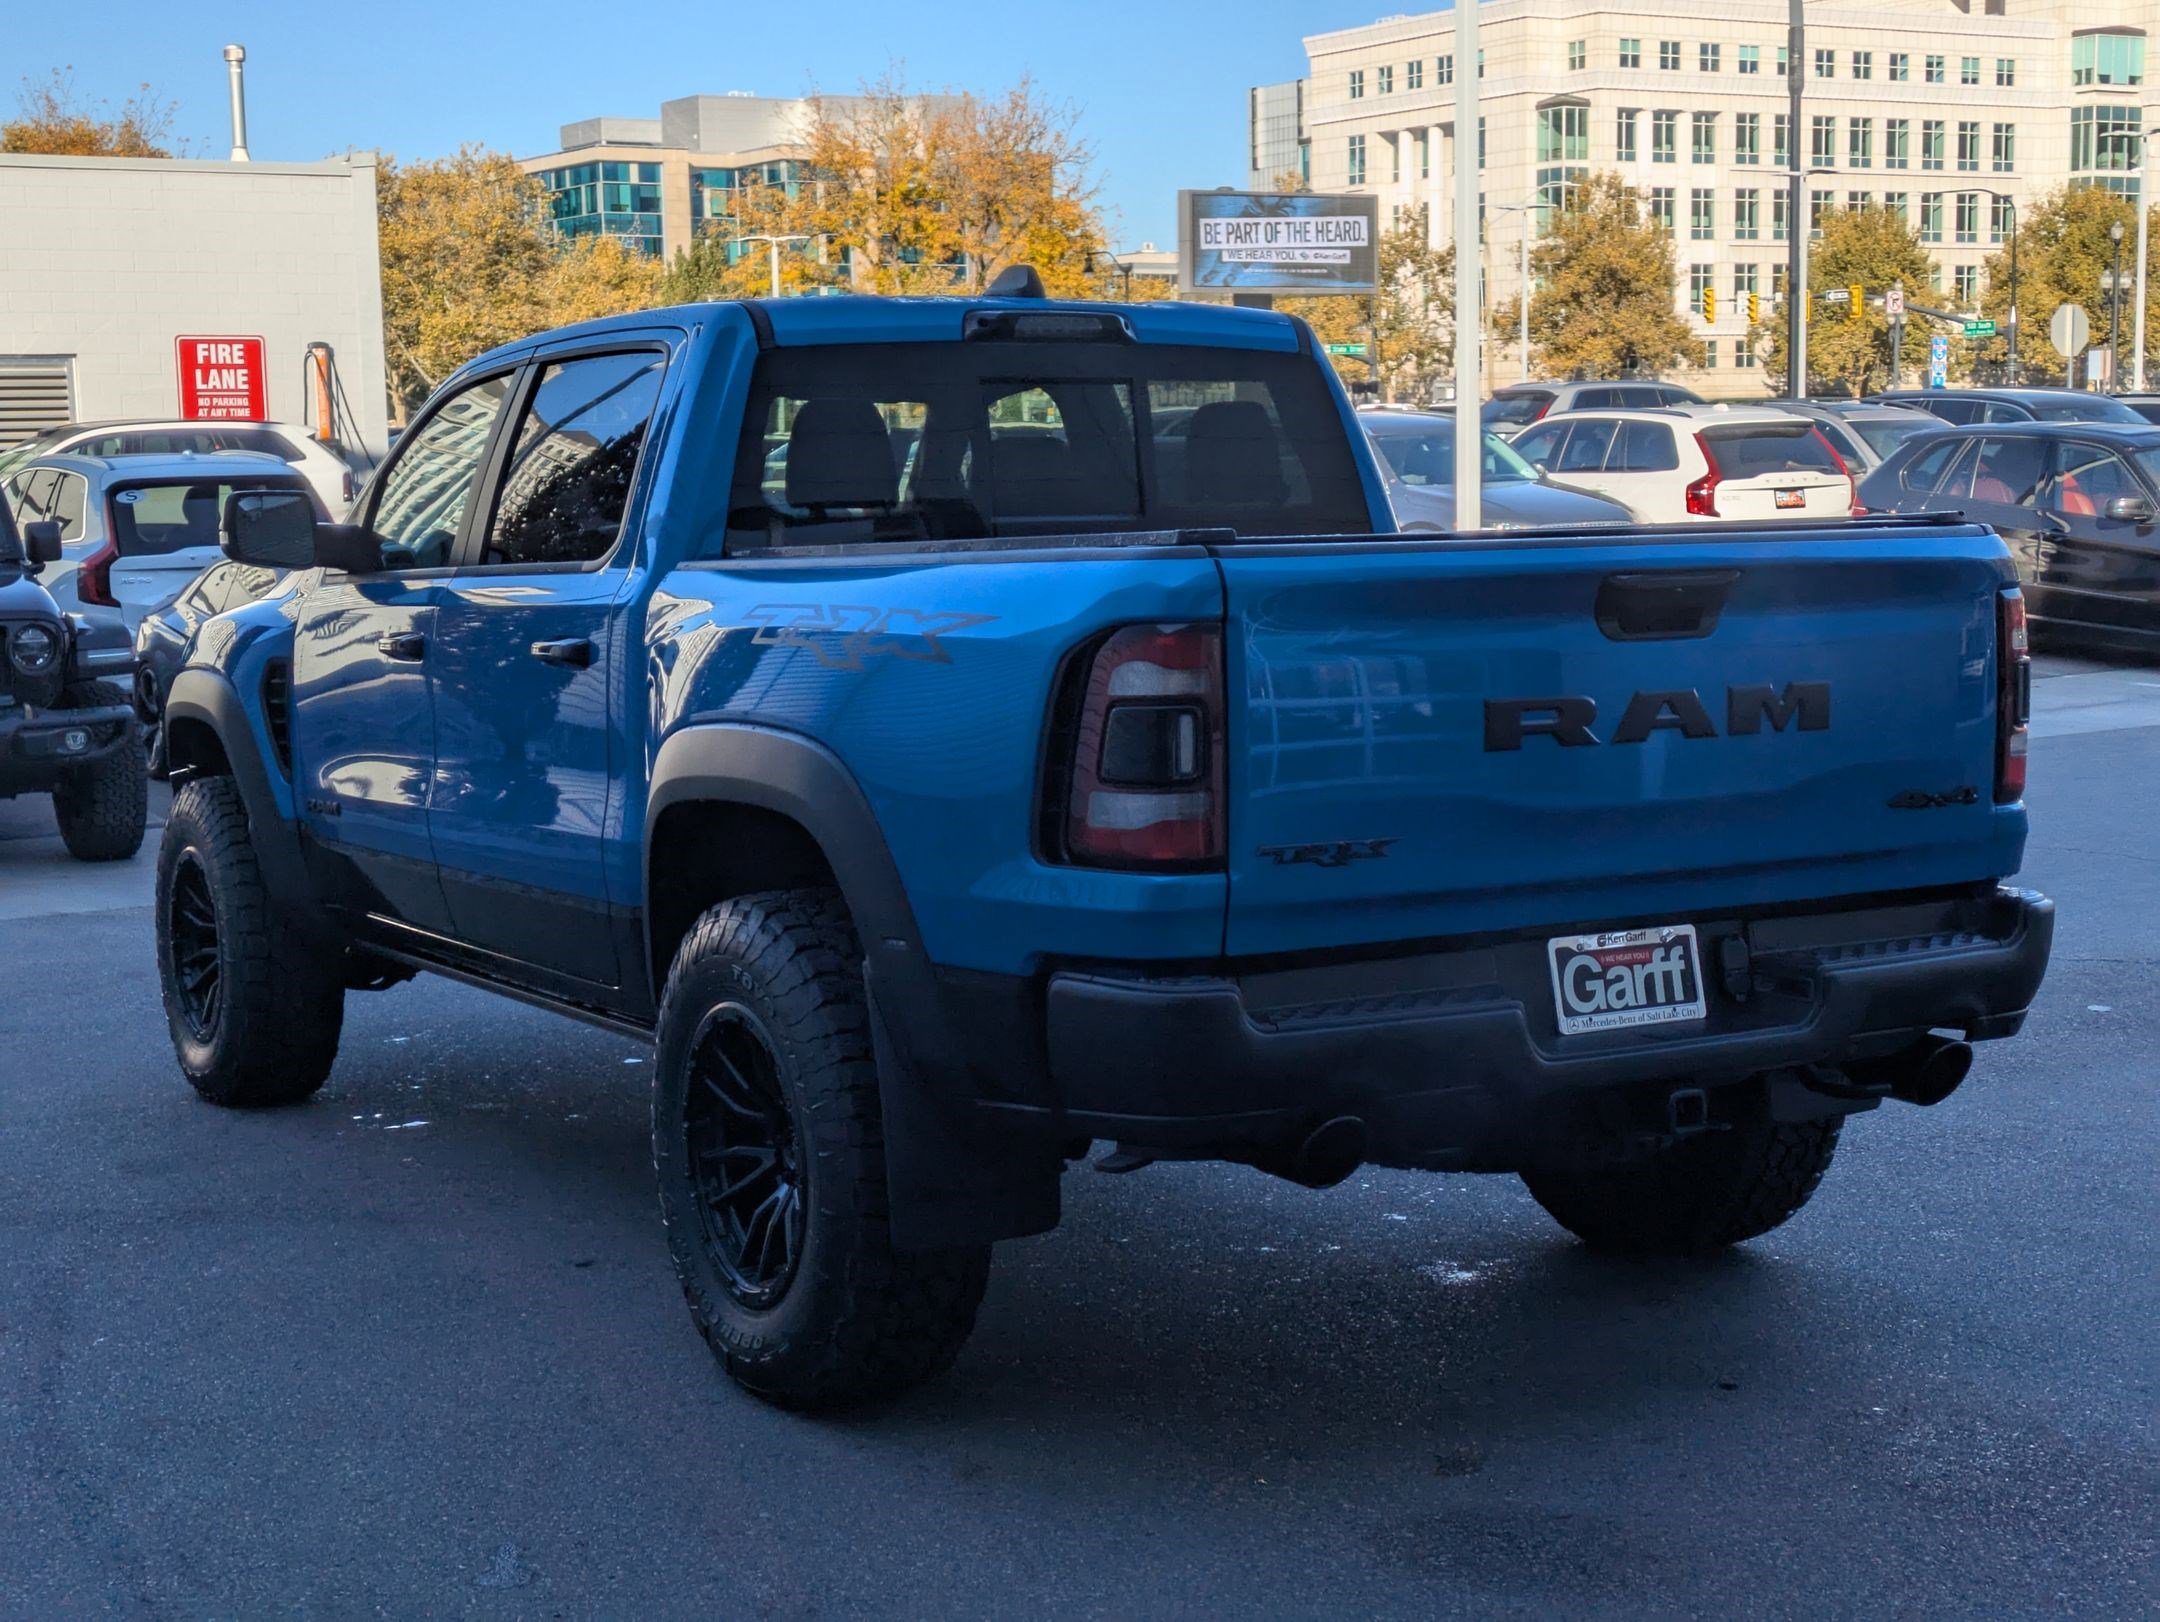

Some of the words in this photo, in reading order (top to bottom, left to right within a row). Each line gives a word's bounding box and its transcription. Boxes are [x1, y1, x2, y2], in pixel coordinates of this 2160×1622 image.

[1203, 222, 1222, 245] BE
[1226, 221, 1262, 244] PART
[1264, 221, 1281, 244] OF
[1284, 220, 1312, 243] THE
[1315, 219, 1366, 243] HEARD.
[1227, 250, 1244, 260] WE
[1245, 250, 1273, 260] HEAR
[1275, 250, 1297, 261] YOU.
[195, 343, 245, 365] FIRE
[195, 369, 249, 390] LANE
[198, 397, 211, 407] NO
[213, 397, 249, 407] PARKING
[198, 408, 208, 417] AT
[210, 408, 228, 417] ANY
[229, 408, 251, 417] TIME
[125, 491, 138, 501] S
[1484, 682, 1831, 752] RAM
[1607, 931, 1625, 944] Ken
[1625, 931, 1647, 943] Garff
[1605, 955, 1615, 963] WE
[1615, 953, 1633, 962] HEAR
[1633, 952, 1646, 960] YOU
[1563, 945, 1686, 1014] Garff
[1581, 1014, 1636, 1028] Mercedes-Benz
[1637, 1012, 1646, 1022] of
[1646, 1011, 1661, 1022] Salt
[1663, 1009, 1680, 1019] Lake
[1681, 1007, 1697, 1019] City
